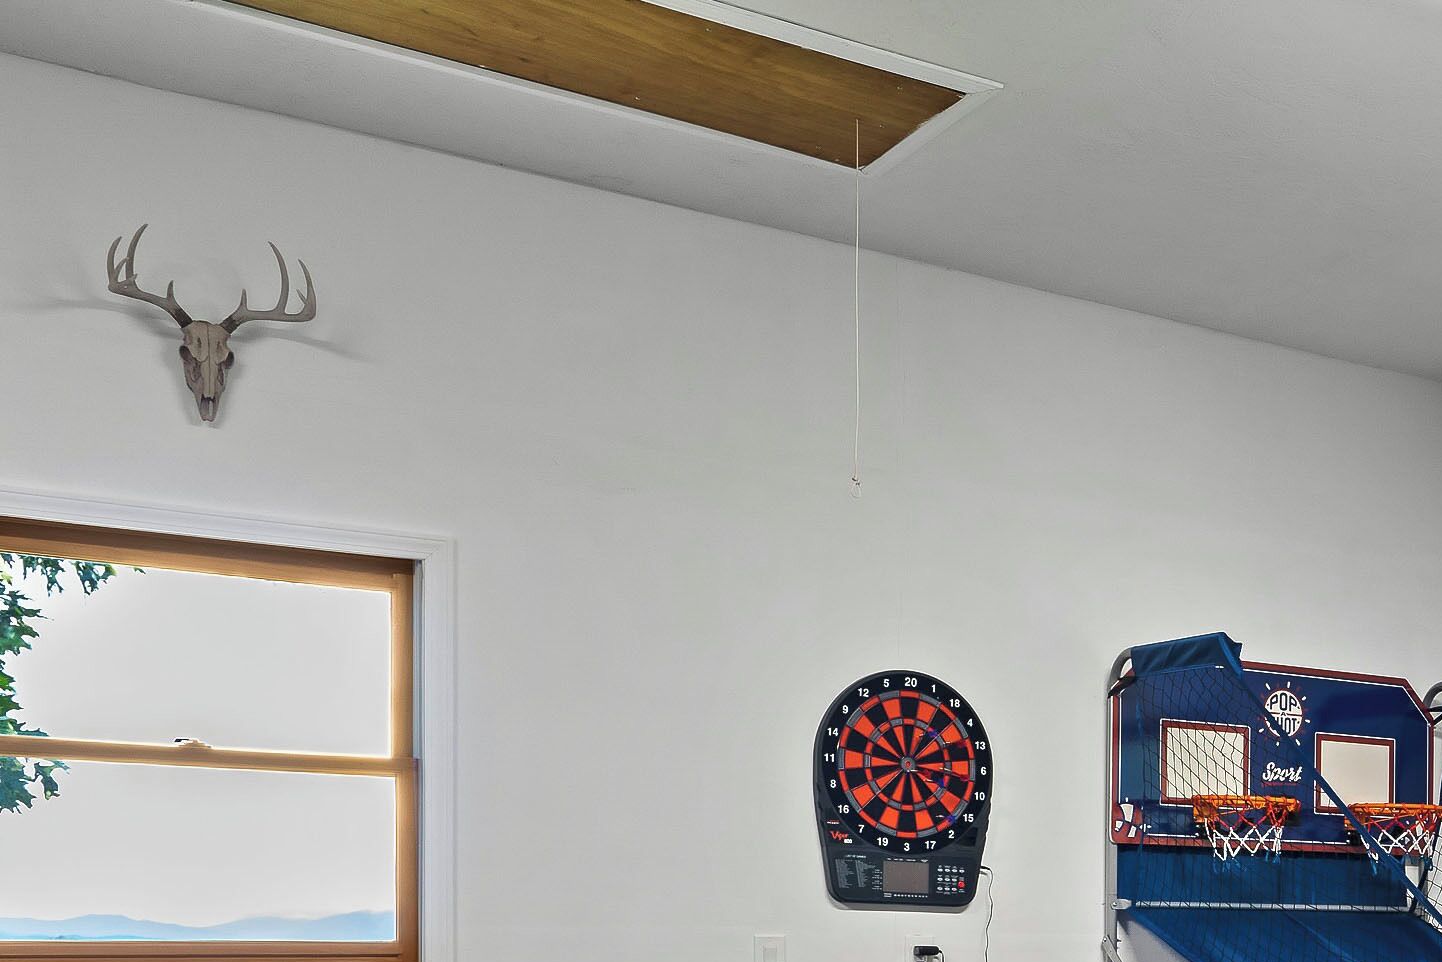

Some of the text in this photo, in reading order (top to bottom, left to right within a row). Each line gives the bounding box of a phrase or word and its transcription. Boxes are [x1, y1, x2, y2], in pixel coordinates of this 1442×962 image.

[884, 679, 889, 687] 5
[905, 677, 917, 687] 20
[931, 684, 936, 692] 1
[858, 688, 869, 697] 12
[950, 699, 960, 707] 18
[1270, 692, 1297, 711] POP
[843, 705, 848, 714] 9
[1275, 716, 1297, 734] HOT
[828, 728, 838, 736] 14
[974, 741, 986, 750] 13
[824, 753, 834, 762] 11
[981, 767, 986, 775] 6
[1262, 761, 1303, 782] Sport
[830, 780, 836, 788] 8
[975, 792, 985, 800] 10
[838, 805, 849, 813] 16
[963, 814, 973, 822] 15
[859, 825, 864, 833] 7
[949, 830, 954, 838] 2
[877, 837, 888, 846] 19
[925, 841, 936, 849] 17
[904, 843, 910, 851] 3
